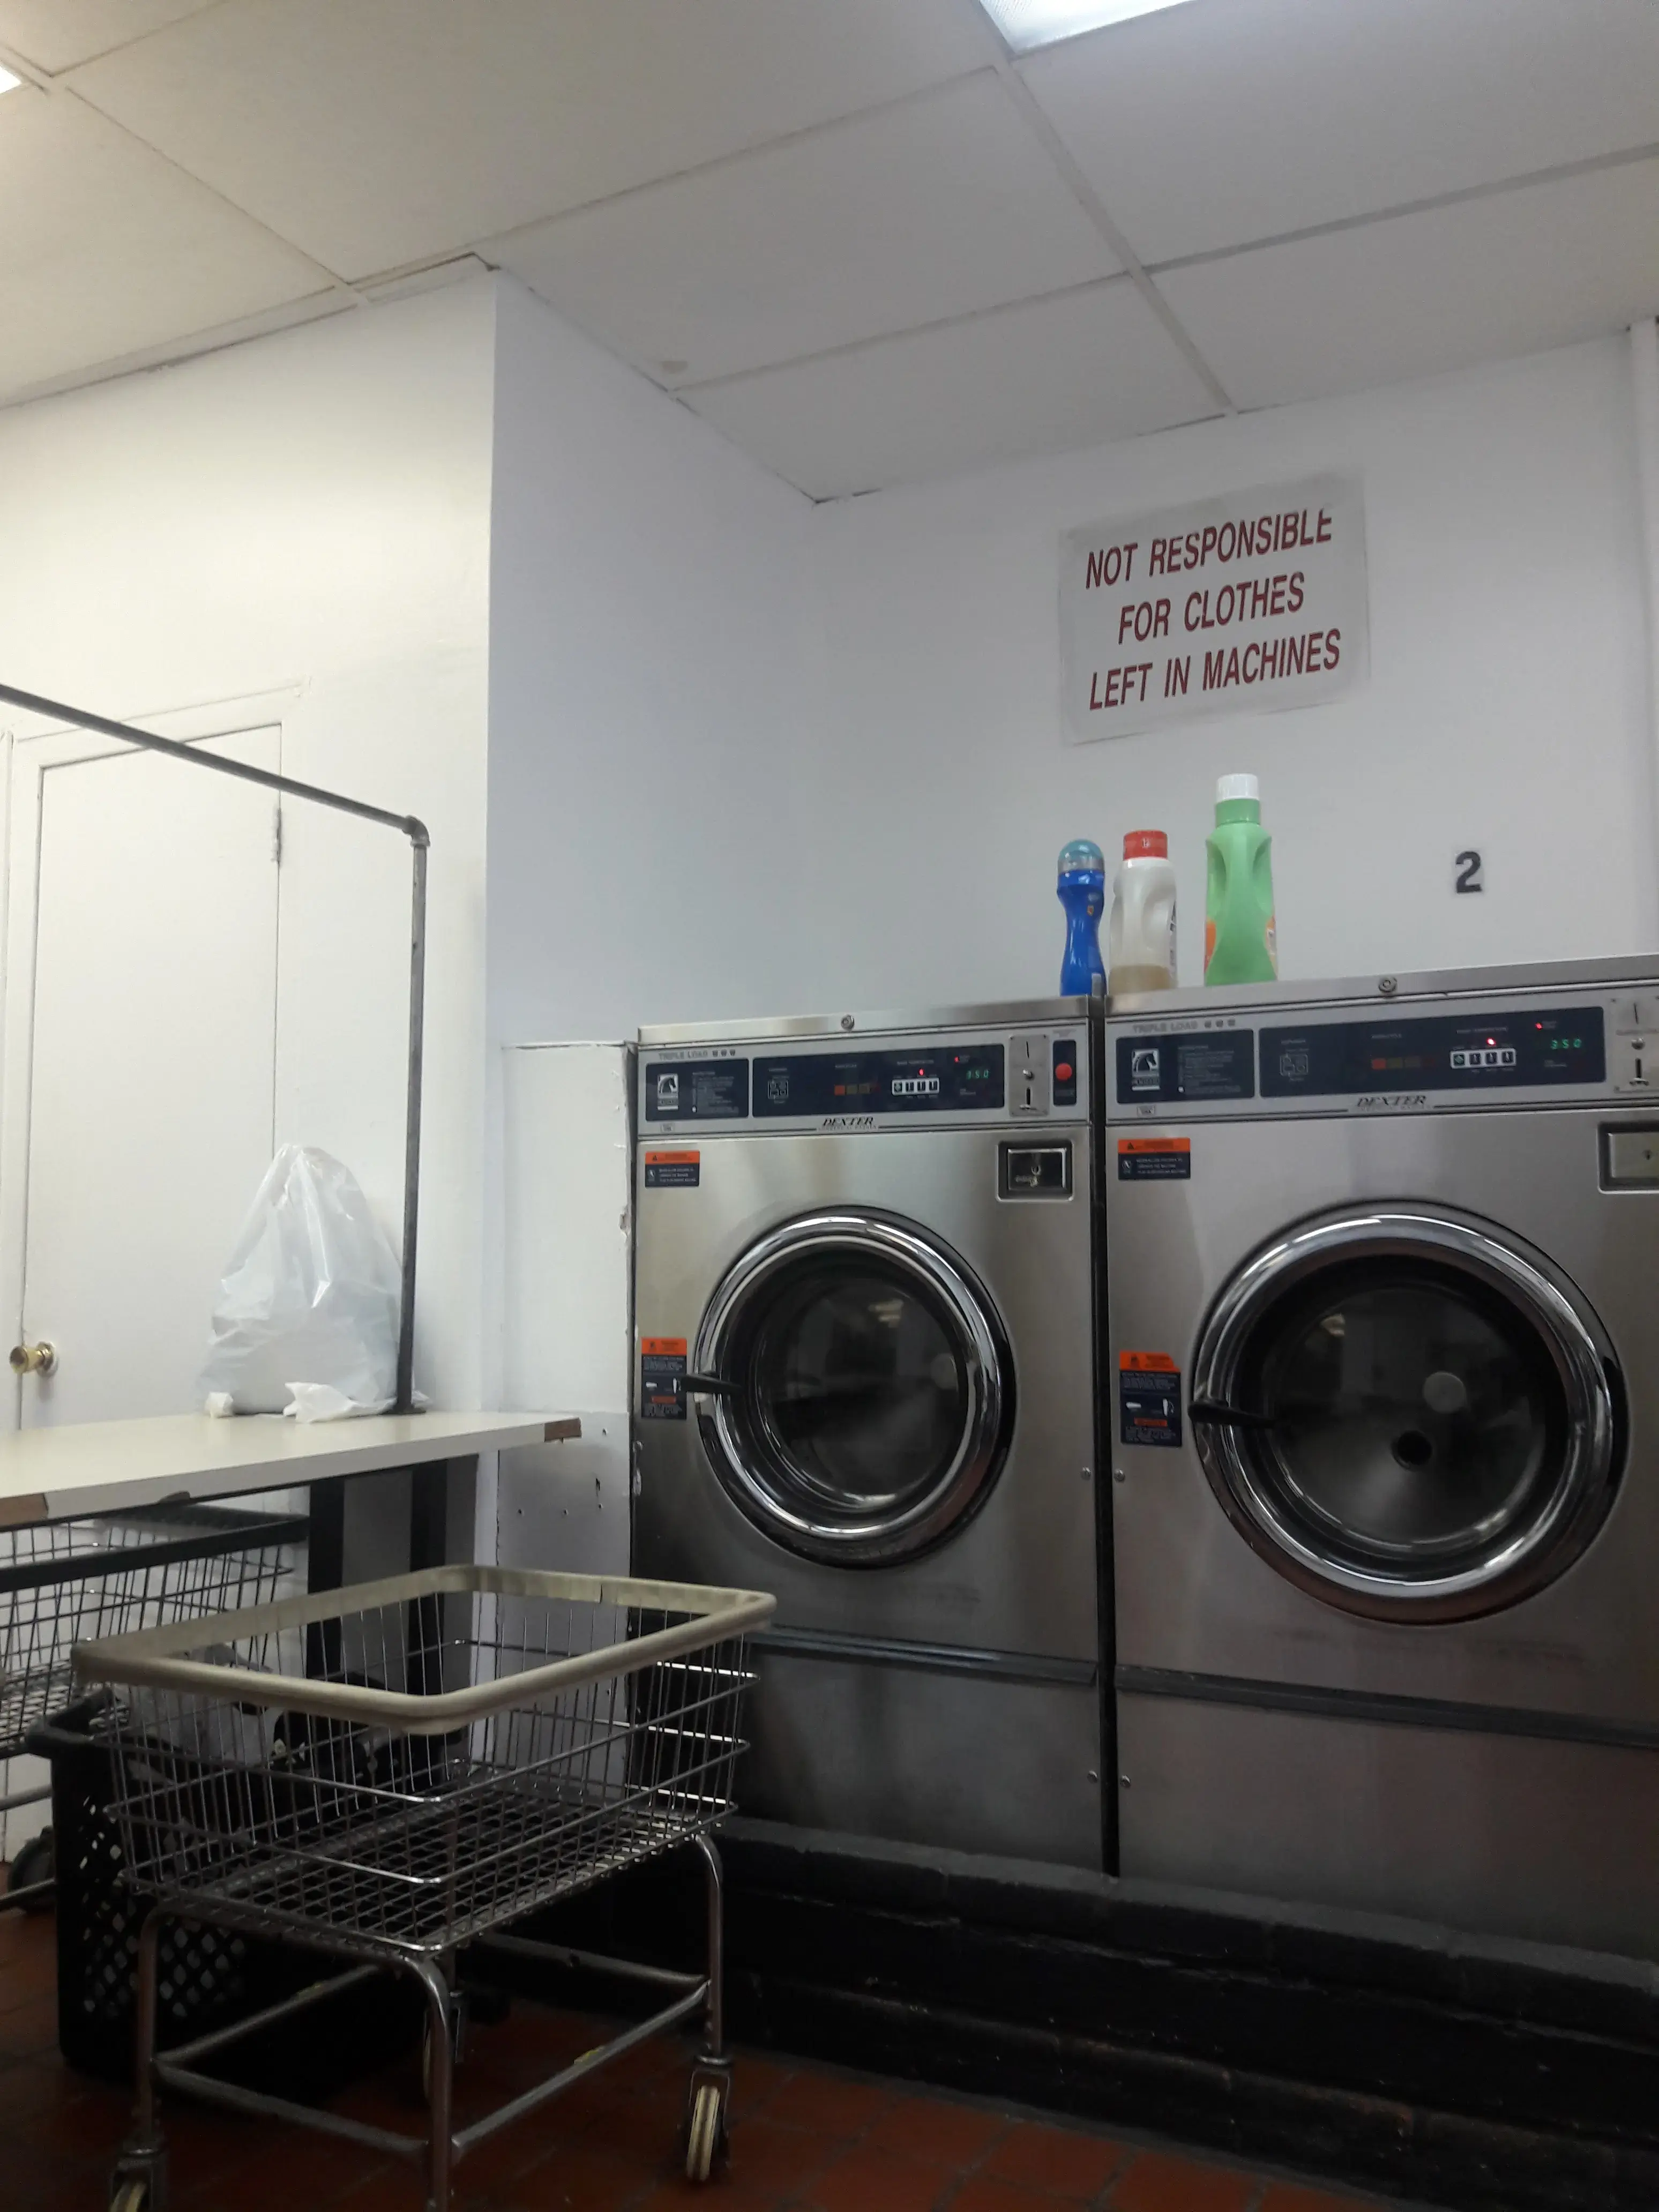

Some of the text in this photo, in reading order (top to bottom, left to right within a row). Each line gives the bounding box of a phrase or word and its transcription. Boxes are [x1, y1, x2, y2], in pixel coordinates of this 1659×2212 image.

[1086, 508, 1332, 589] NOT RESPONSIBLE
[1118, 572, 1304, 645] FOR CLOTHES
[1089, 629, 1340, 710] LEFT IN MACHINES
[1456, 851, 1482, 893] 2
[823, 1116, 874, 1126] DEXTER
